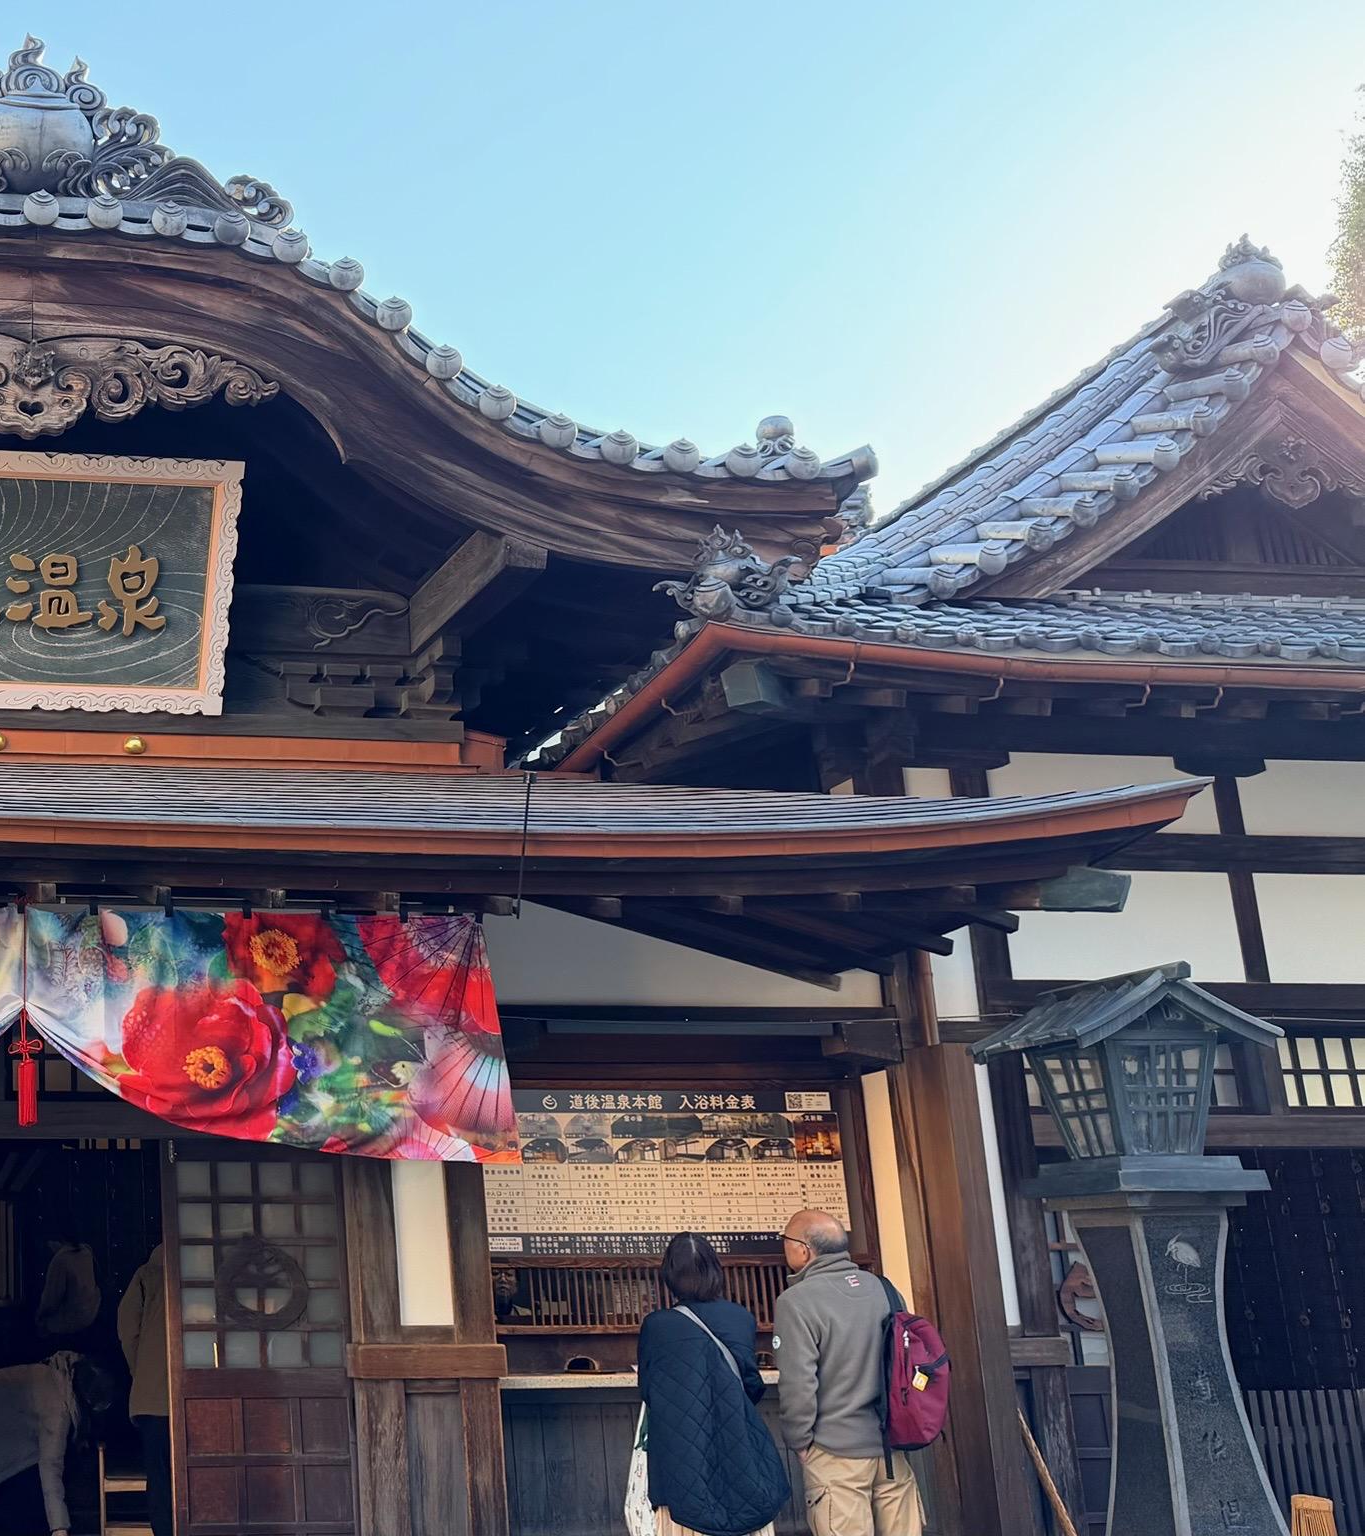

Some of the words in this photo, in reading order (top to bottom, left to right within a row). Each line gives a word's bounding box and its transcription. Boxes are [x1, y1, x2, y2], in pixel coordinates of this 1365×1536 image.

[569, 1094, 663, 1110] 道後温泉本館
[679, 1094, 756, 1110] 入浴料金表
